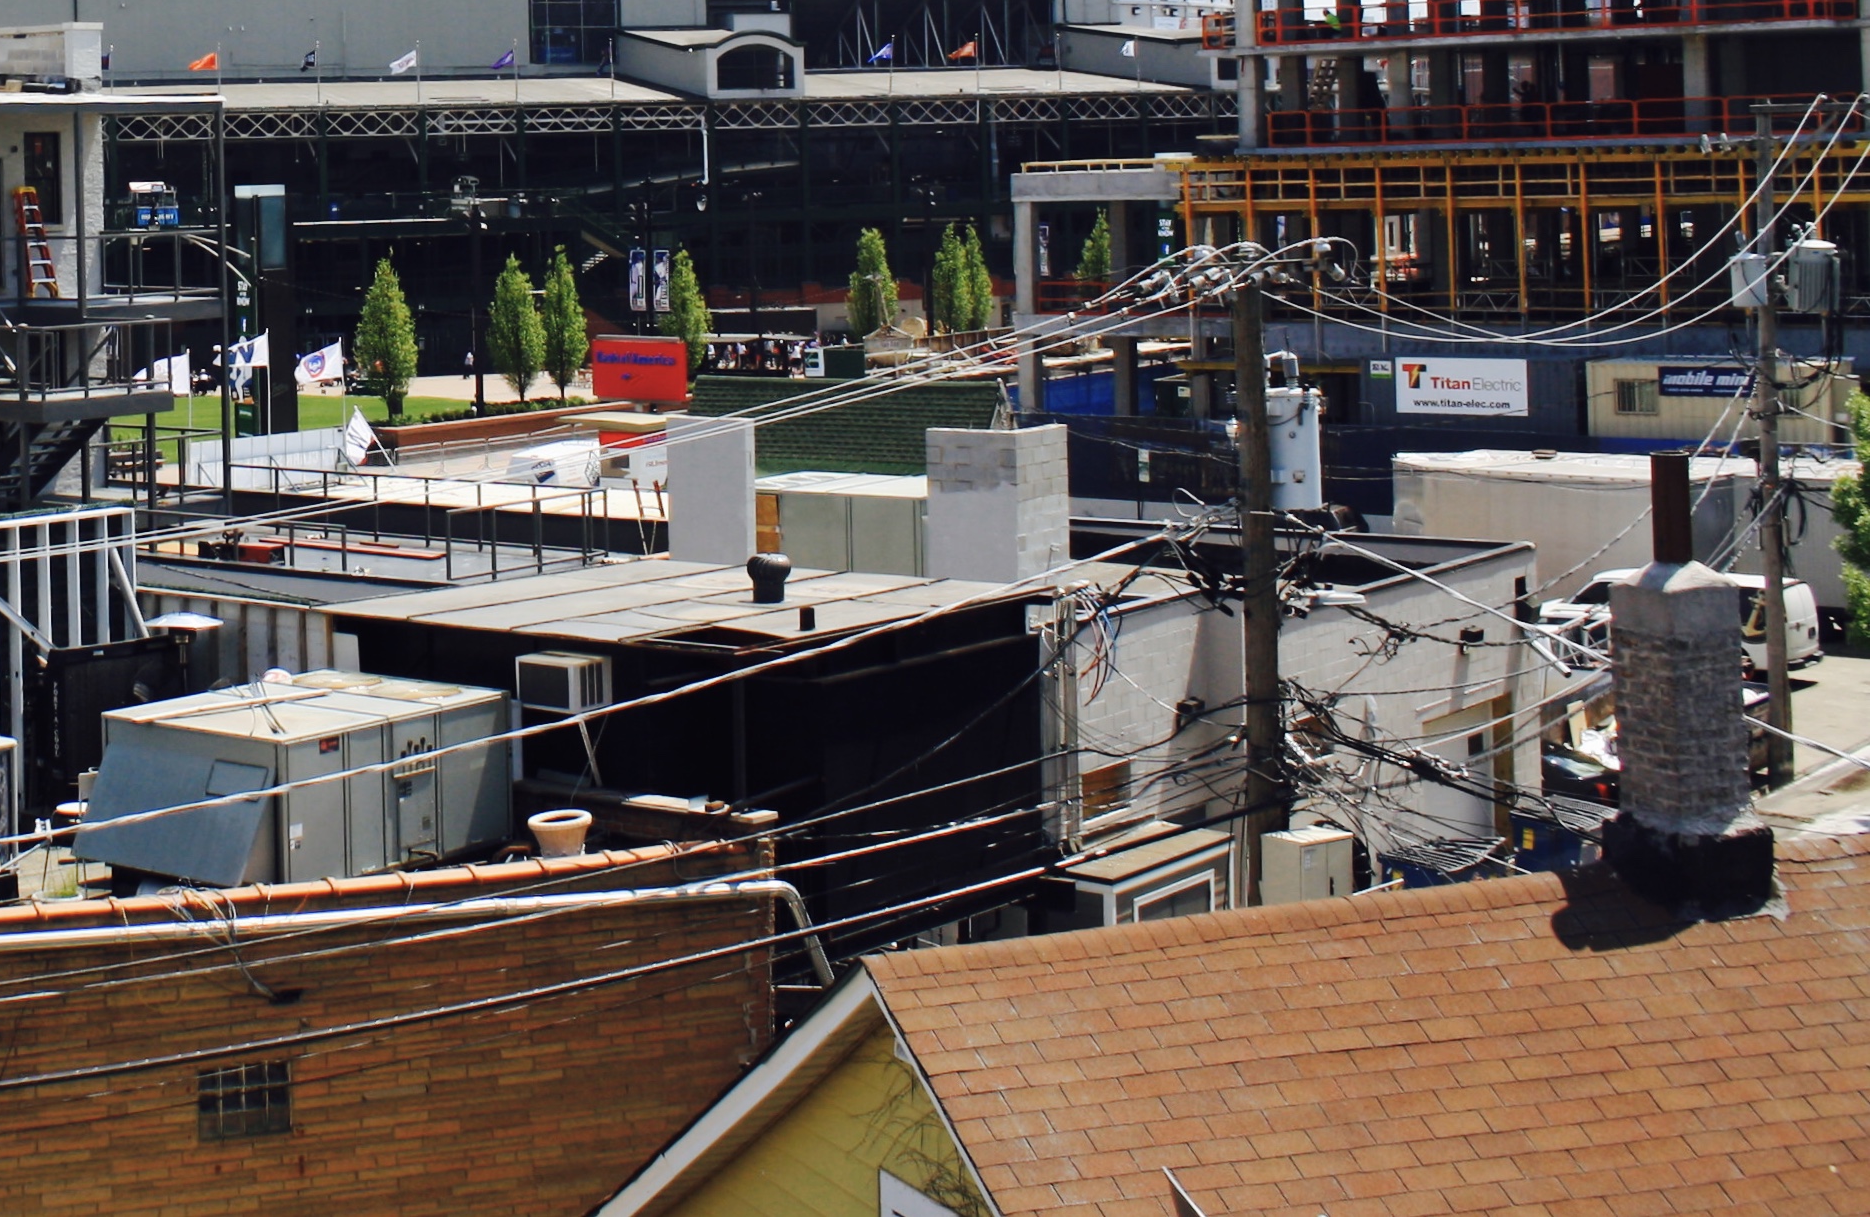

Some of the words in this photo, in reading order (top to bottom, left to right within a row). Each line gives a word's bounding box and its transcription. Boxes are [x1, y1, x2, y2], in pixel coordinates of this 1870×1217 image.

[1430, 377, 1471, 391] Titan
[1472, 377, 1522, 392] Electric
[1413, 399, 1511, 410] www.titan-elec.com
